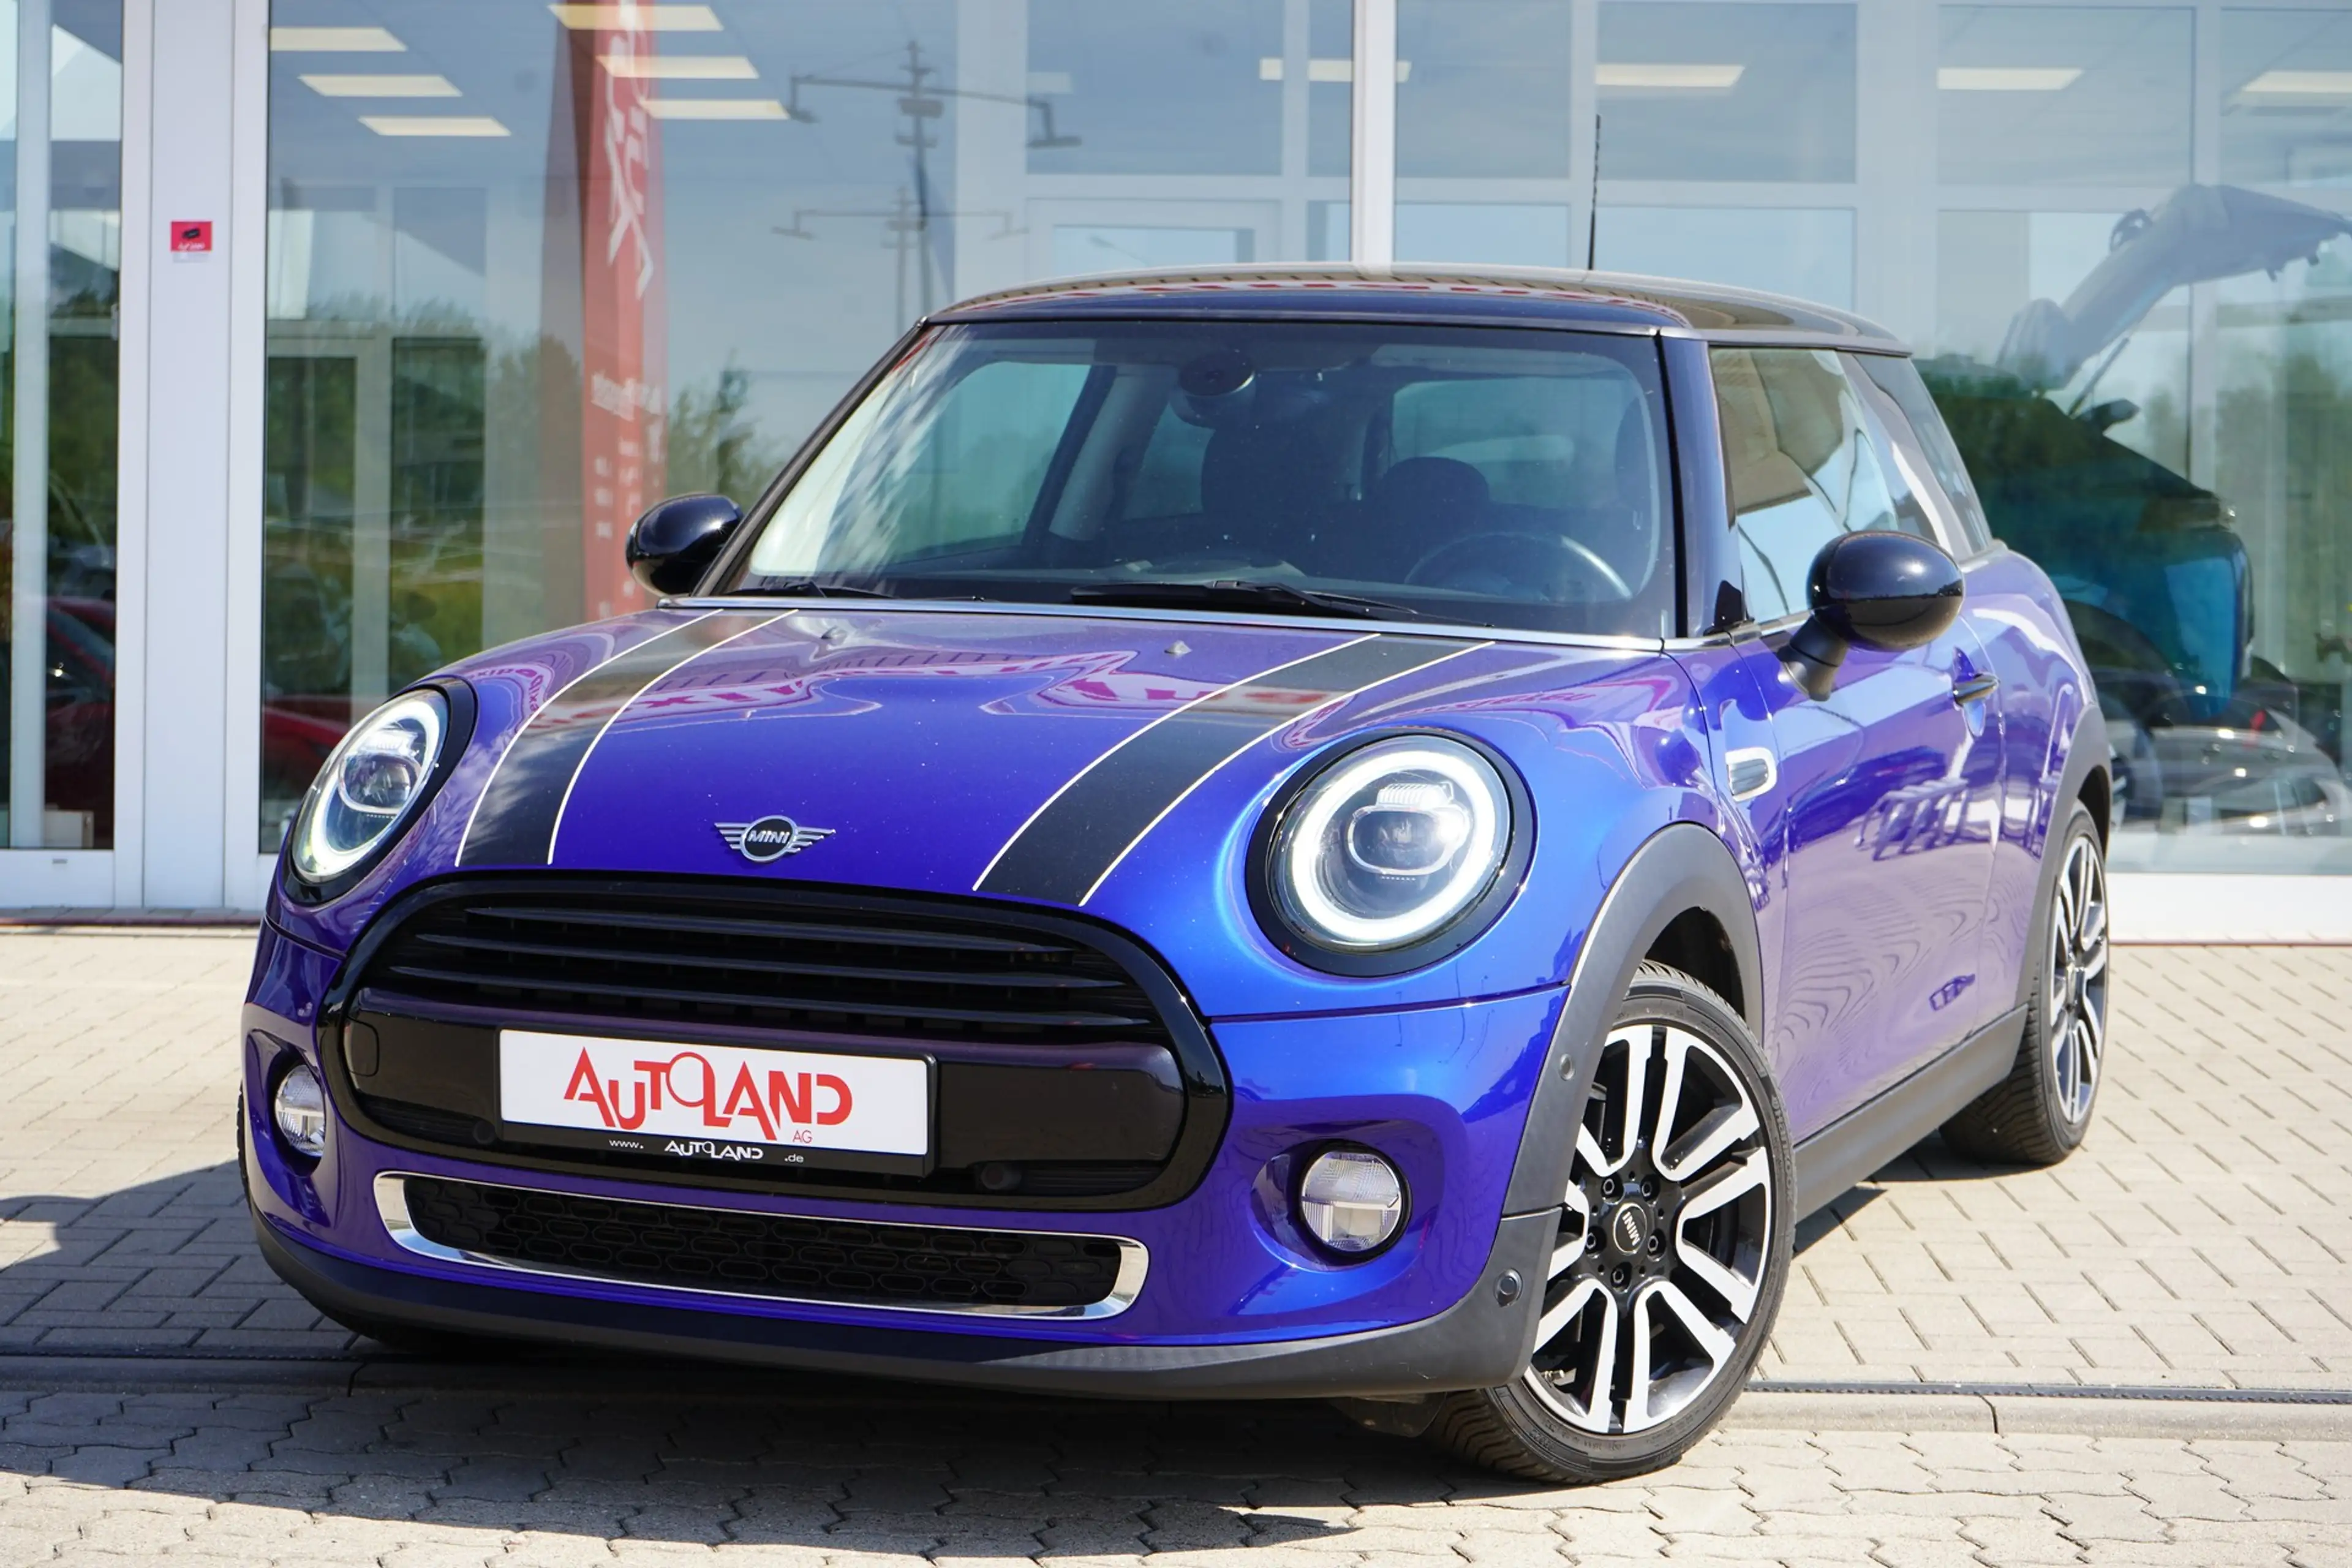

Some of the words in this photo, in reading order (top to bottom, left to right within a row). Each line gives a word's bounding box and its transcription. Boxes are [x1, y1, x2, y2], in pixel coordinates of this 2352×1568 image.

[747, 830, 790, 844] MINI
[793, 1129, 813, 1144] AG
[609, 1139, 644, 1149] www.
[784, 1153, 805, 1163] .de
[1622, 1211, 1641, 1246] MINI
